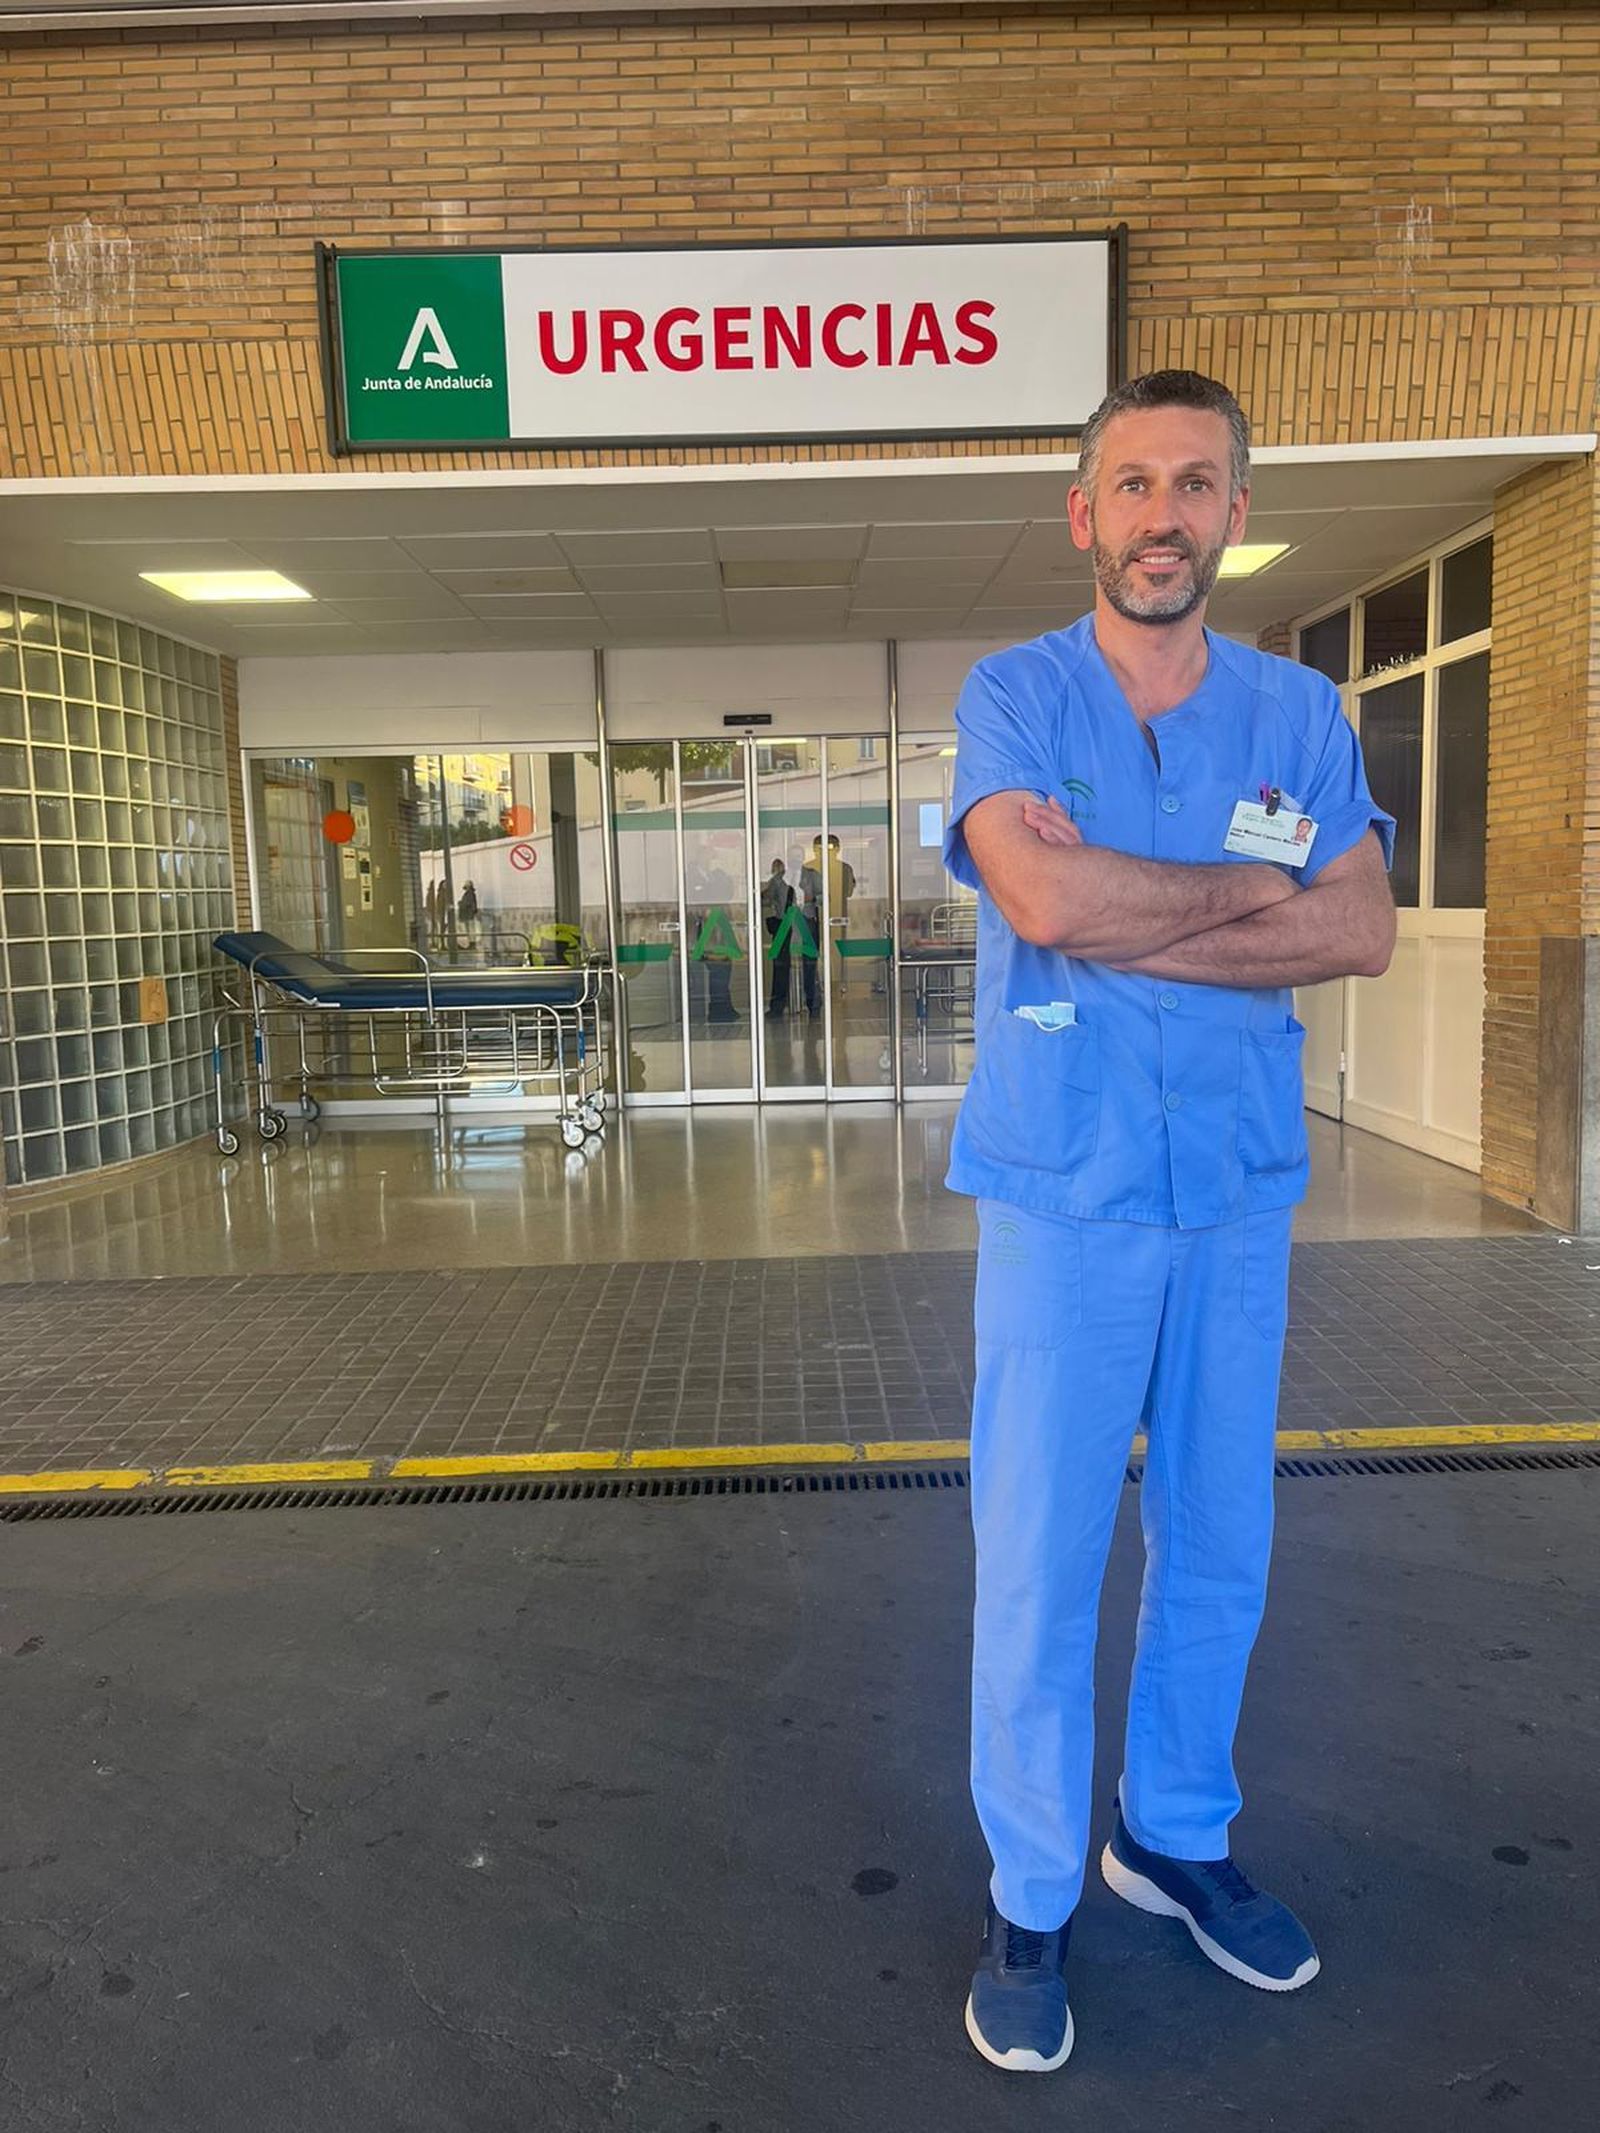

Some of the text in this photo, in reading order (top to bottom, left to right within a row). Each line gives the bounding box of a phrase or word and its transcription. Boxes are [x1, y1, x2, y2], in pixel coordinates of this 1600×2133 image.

[538, 300, 998, 375] URGENCIAS
[362, 374, 494, 391] Junta de Andalucía
